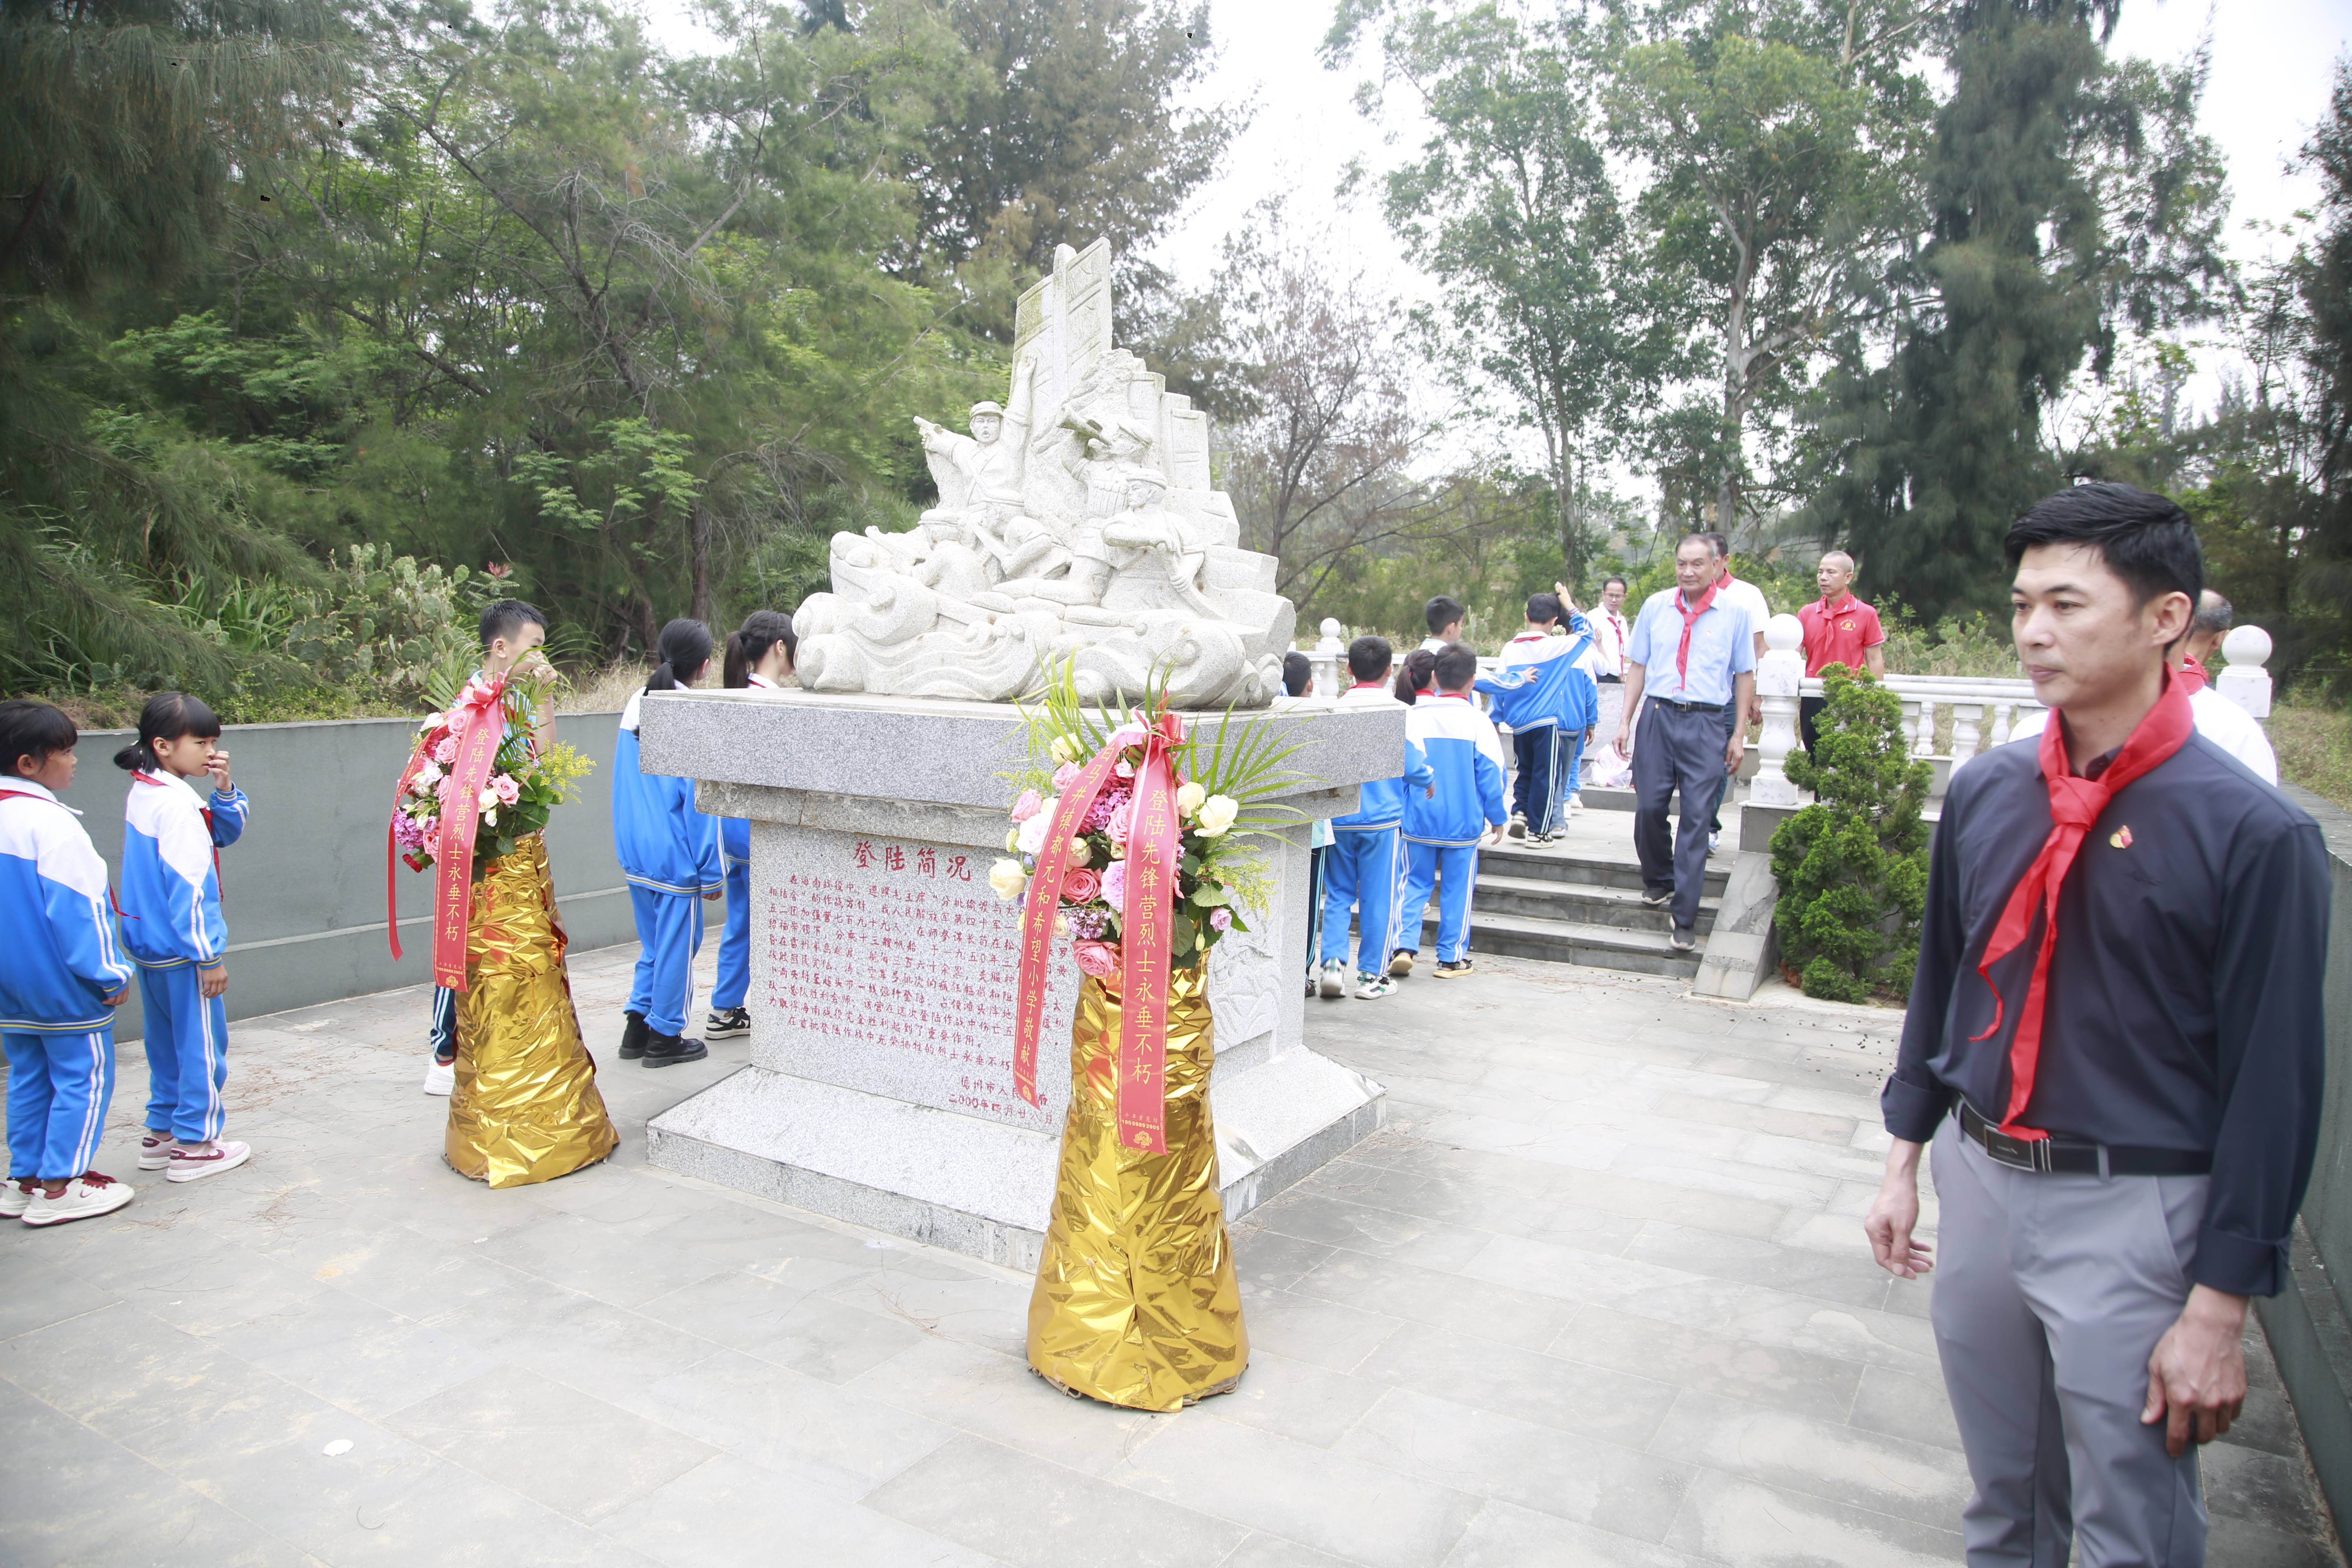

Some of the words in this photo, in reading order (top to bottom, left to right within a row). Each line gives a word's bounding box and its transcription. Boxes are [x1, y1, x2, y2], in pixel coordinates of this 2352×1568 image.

[445, 728, 490, 942] 登陆先锋营烈士永垂不朽
[853, 840, 971, 882] 登陆简况
[1020, 741, 1116, 1067] 白马井镇都元和希望小学敬献
[1131, 790, 1168, 1085] 登陆先锋营烈士永垂不朽
[961, 1076, 1047, 1106] 儋州市人民府
[1121, 1119, 1160, 1131] 18089892905
